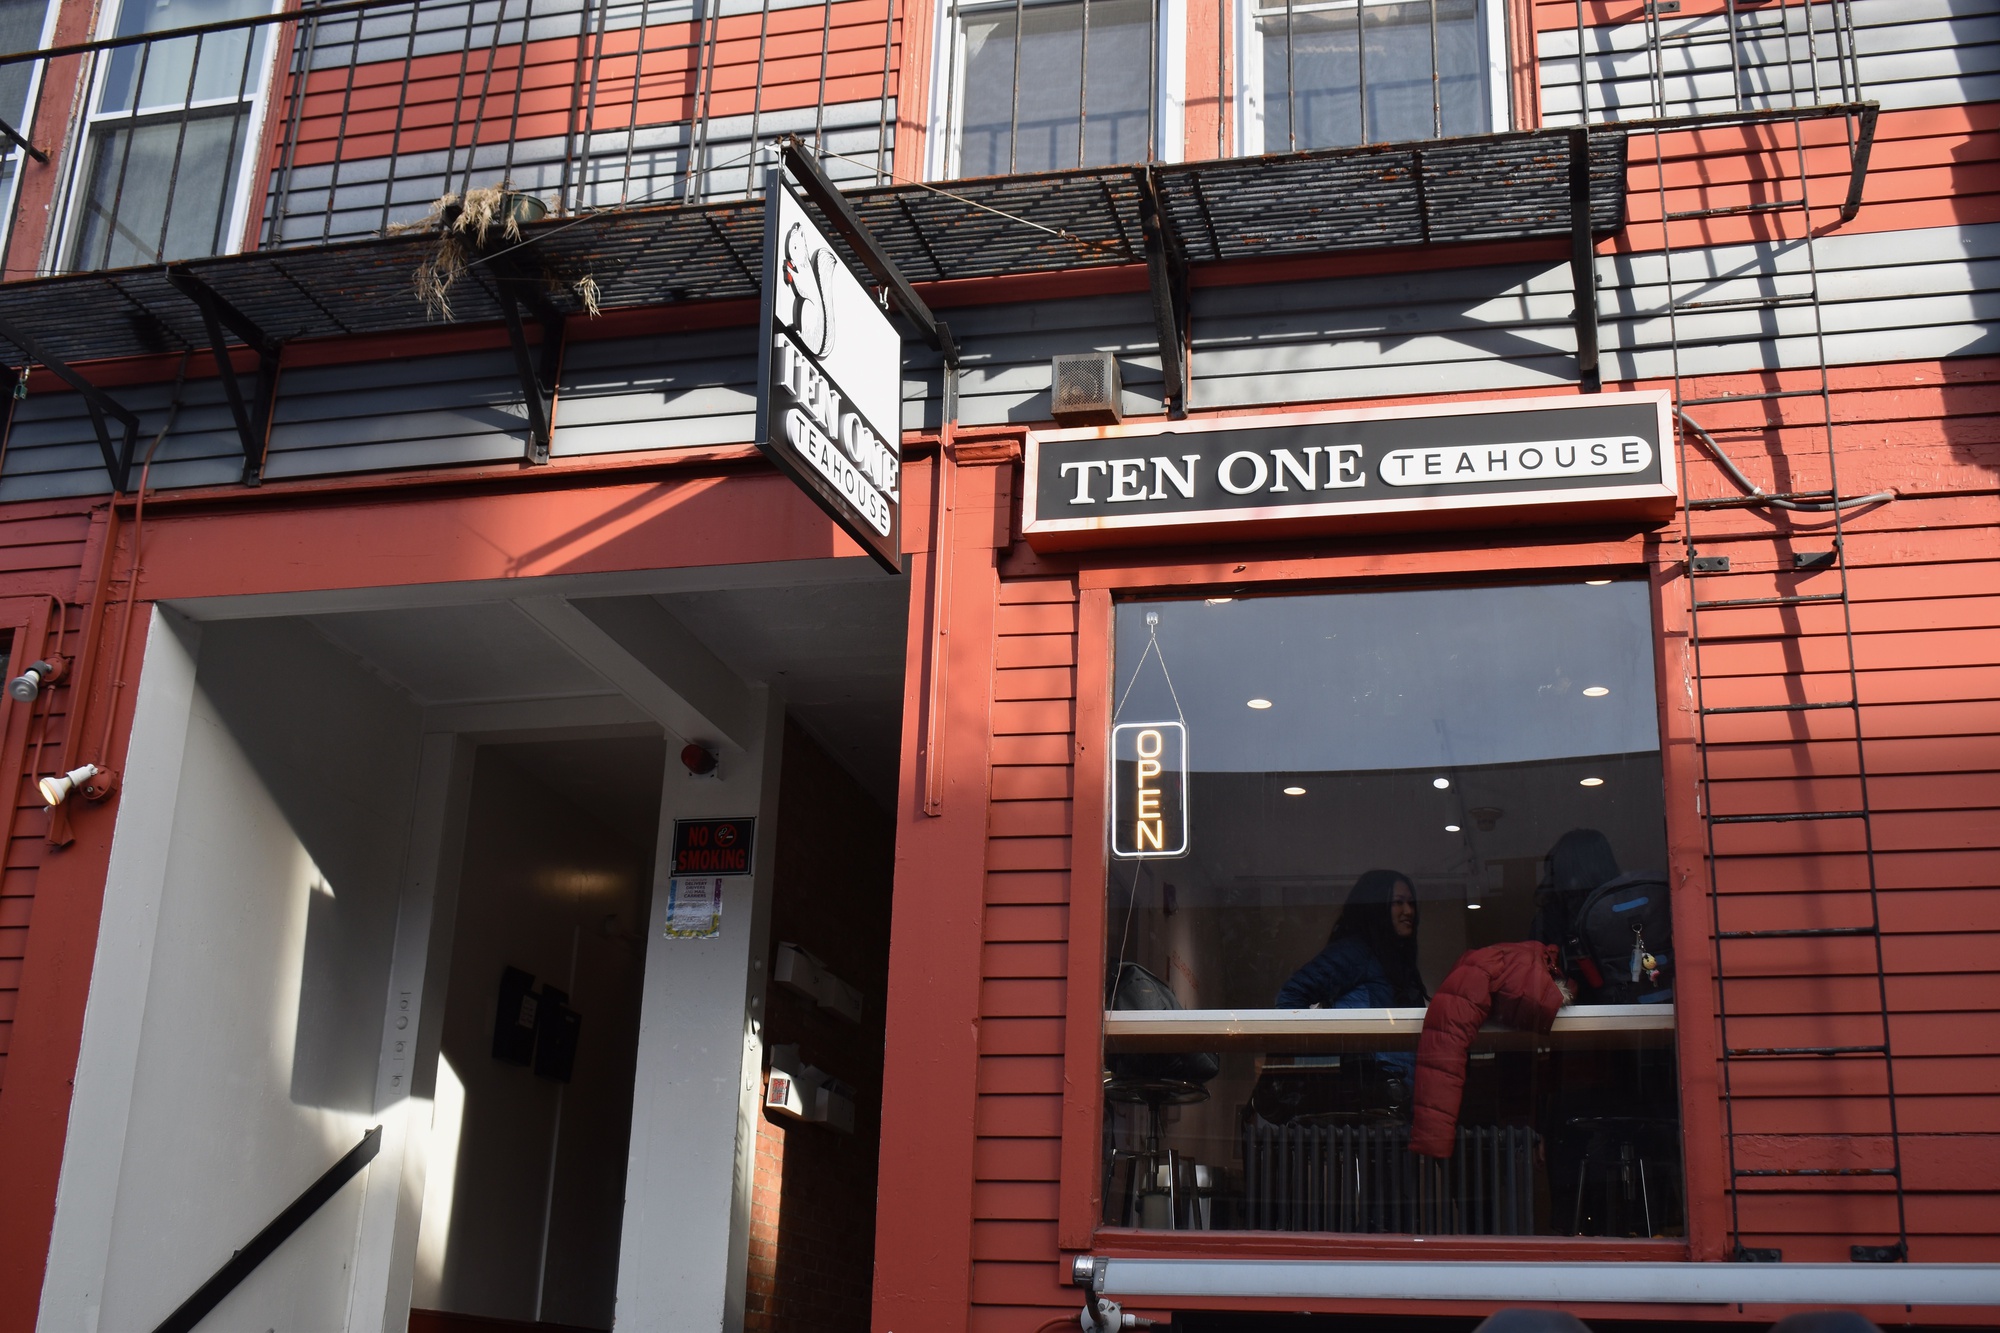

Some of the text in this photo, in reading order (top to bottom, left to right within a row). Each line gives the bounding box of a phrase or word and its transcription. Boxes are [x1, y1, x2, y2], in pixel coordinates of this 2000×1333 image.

[774, 332, 899, 504] TEN ONE
[795, 415, 887, 530] TEAHOUSE
[1060, 442, 1640, 504] TEN ONE TEAHOUSE
[1137, 729, 1163, 850] OPEN
[678, 848, 745, 871] SMOKING
[688, 825, 708, 847] NO
